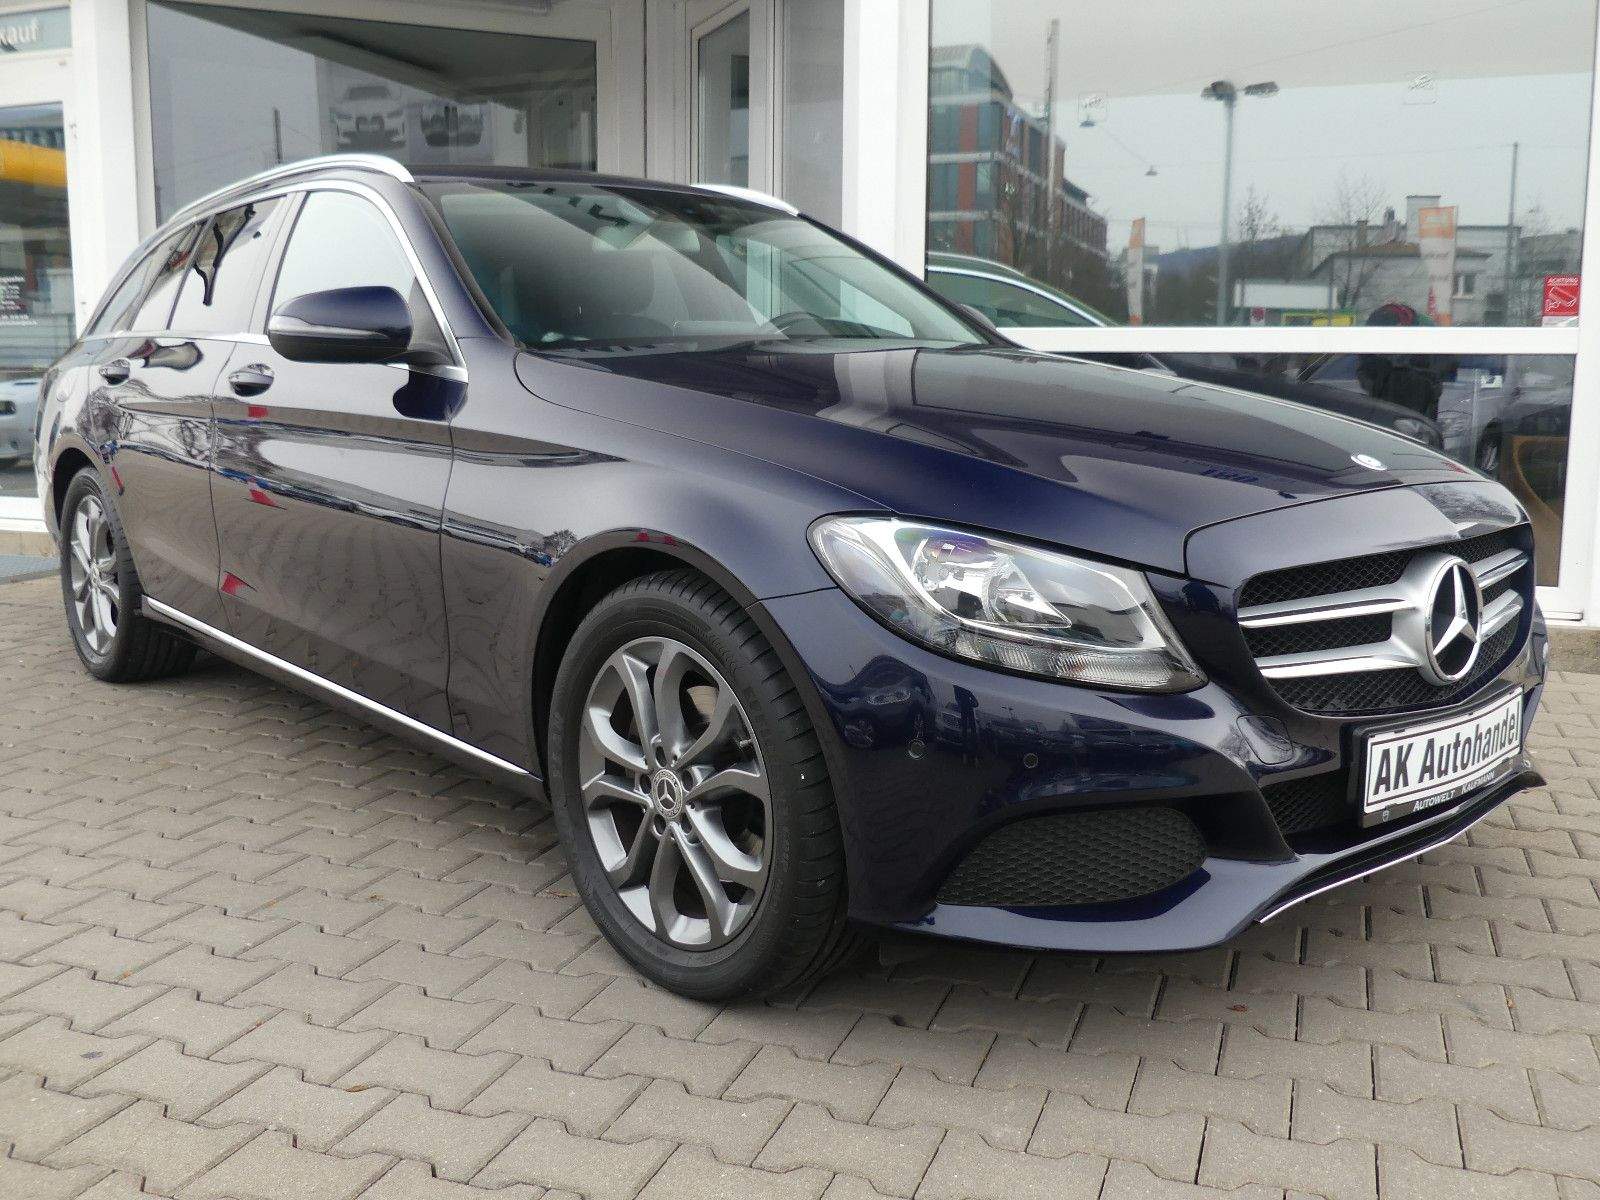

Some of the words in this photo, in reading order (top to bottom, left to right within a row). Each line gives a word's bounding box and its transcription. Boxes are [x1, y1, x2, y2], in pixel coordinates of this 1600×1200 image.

[1373, 743, 1412, 796] AK
[1418, 700, 1520, 784] Autohandel
[1413, 790, 1455, 812] AUTOWELT
